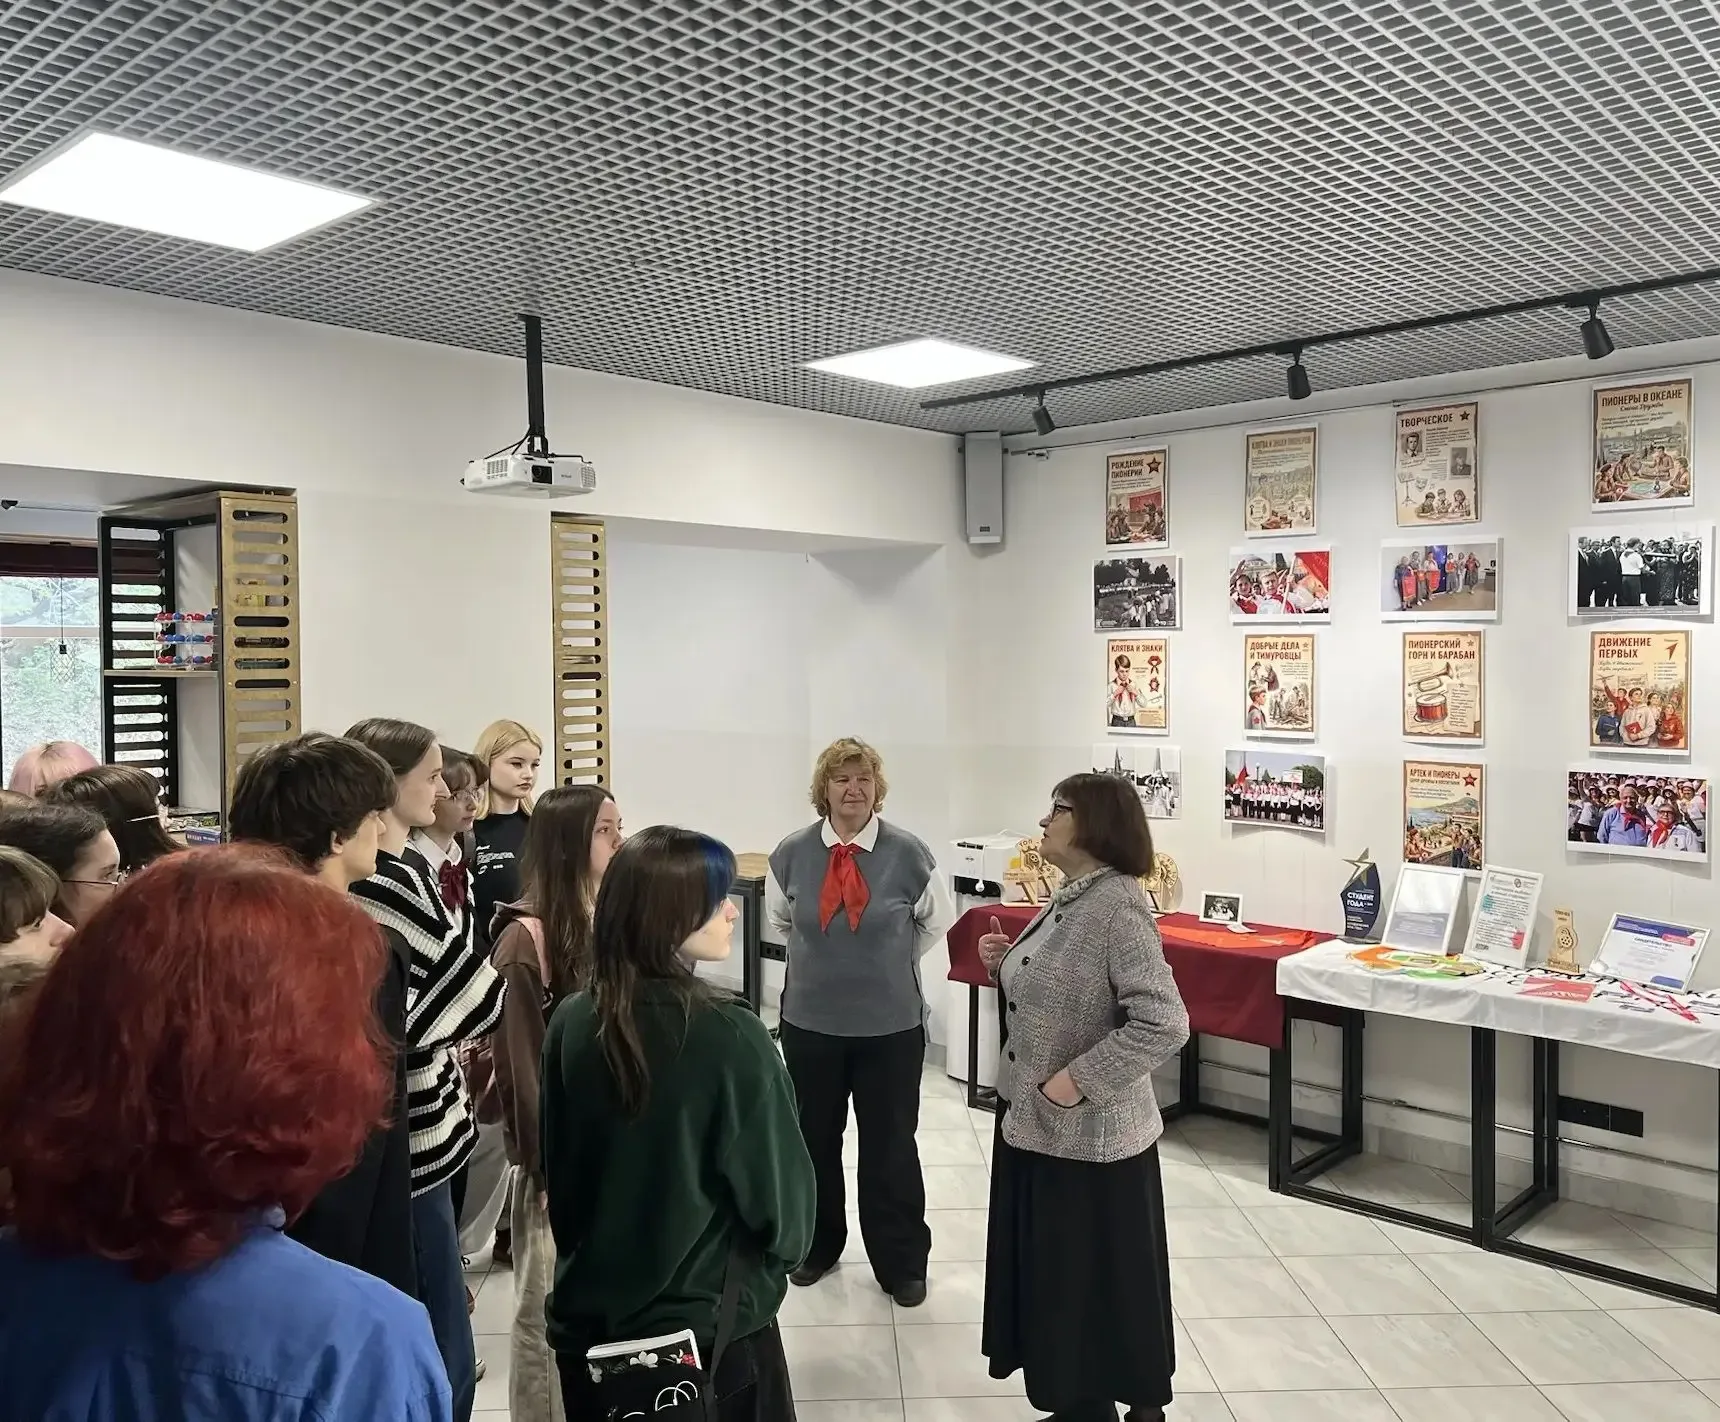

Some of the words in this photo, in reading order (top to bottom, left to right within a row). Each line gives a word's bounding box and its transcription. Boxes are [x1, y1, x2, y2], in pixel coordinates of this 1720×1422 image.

[1602, 394, 1641, 407] ПИОНЕРЫ
[1643, 393, 1649, 402] В
[1650, 389, 1683, 402] ОКЕАНЕ
[1401, 413, 1453, 428] ТВОРЧЕСКОЕ
[1111, 459, 1144, 469] РОЖДЕНИЕ
[1111, 469, 1142, 478] ПИОНЕРИИ
[1250, 642, 1279, 651] ДОБРЫЕ
[1281, 642, 1300, 650] ДЕЛА
[1408, 638, 1461, 649] ПИОНЕРСКИЙ
[1598, 637, 1652, 648] ДВИЖЕНИЕ
[1250, 652, 1255, 660] И
[1257, 652, 1302, 661] ТИМУРОВЦЫ
[1408, 651, 1428, 659] ГОРН
[1430, 651, 1436, 659] И
[1438, 651, 1475, 659] БАРАБАН
[1598, 649, 1638, 658] ПЕРВЫХ
[1410, 769, 1426, 777] АРТЕК
[1433, 770, 1460, 779] ПИОНЕРЫ
[1347, 892, 1374, 901] СТУДЕНТ
